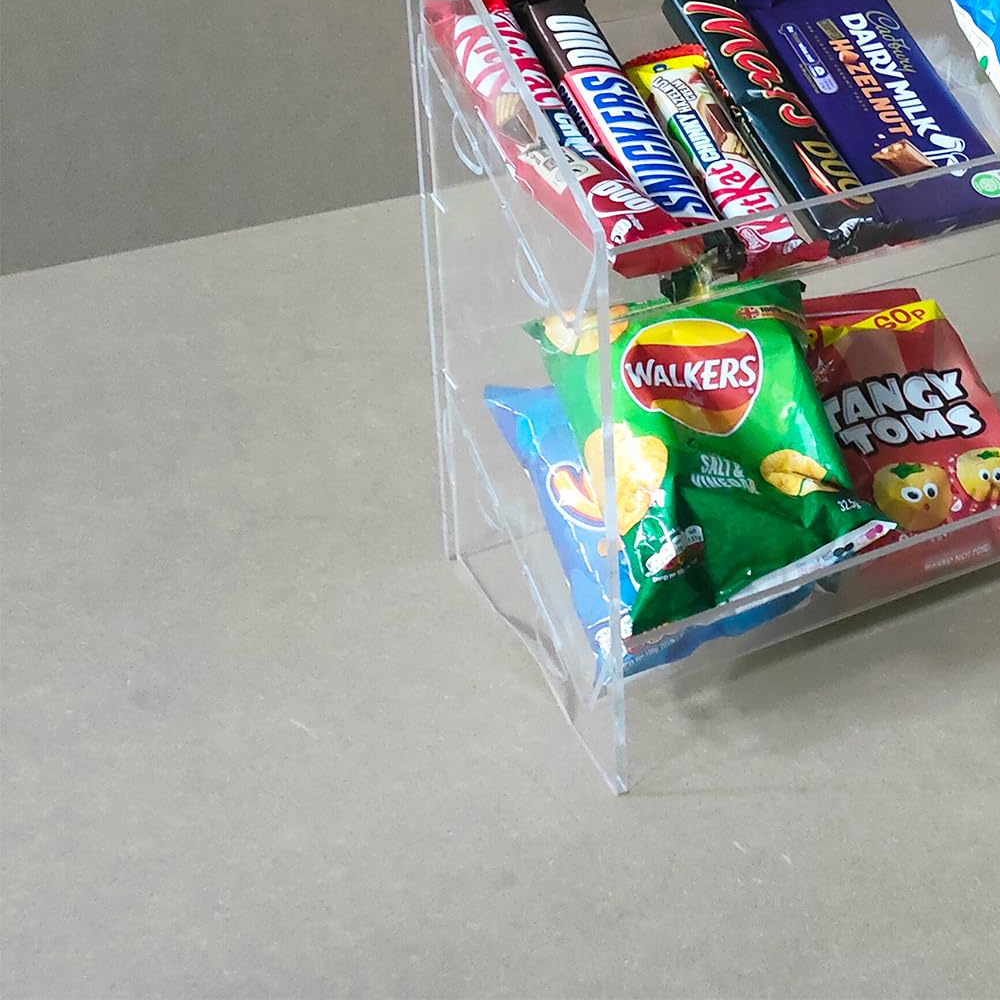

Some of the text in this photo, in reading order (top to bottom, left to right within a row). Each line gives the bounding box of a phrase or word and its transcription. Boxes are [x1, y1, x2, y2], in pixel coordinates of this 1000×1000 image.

[546, 15, 622, 70] DUO
[683, 1, 820, 128] Mars
[865, 10, 916, 73] Cadbury
[652, 77, 692, 113] HAZELNUT
[840, 12, 941, 137] DAIRY MILK
[581, 75, 713, 217] SNICKERS
[677, 112, 720, 162] CHUNKY
[591, 180, 655, 210] DUO
[711, 163, 791, 234] KitKat
[800, 140, 874, 204] DUO
[624, 355, 757, 391] WALKERS
[824, 371, 965, 431] TANGY
[840, 404, 983, 455] TOMS
[700, 454, 745, 478] SALT &
